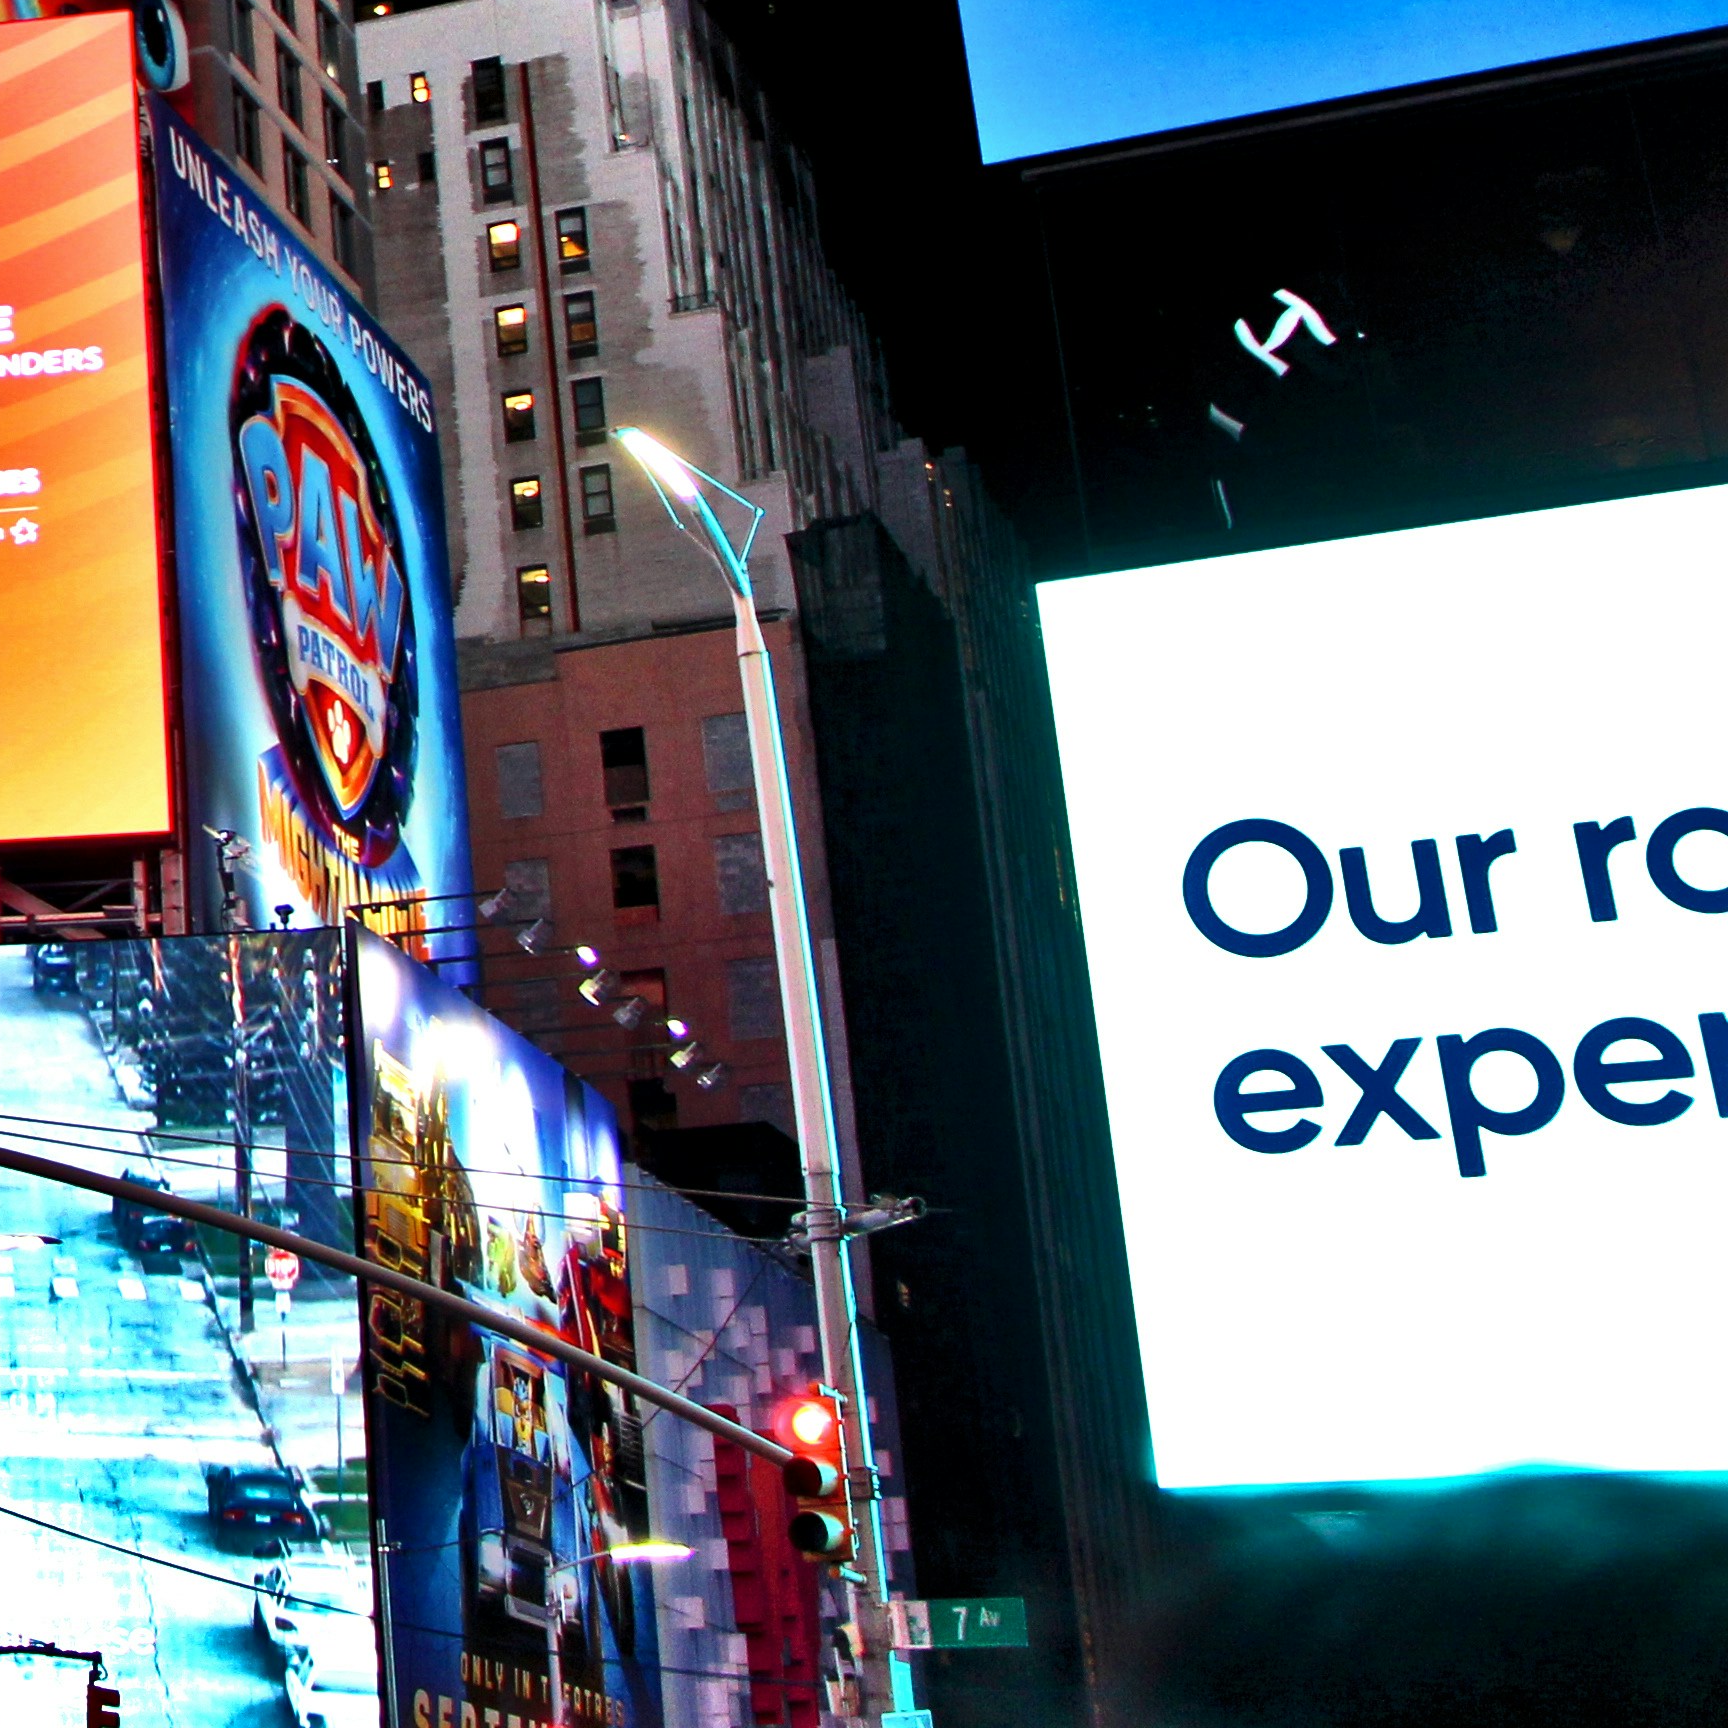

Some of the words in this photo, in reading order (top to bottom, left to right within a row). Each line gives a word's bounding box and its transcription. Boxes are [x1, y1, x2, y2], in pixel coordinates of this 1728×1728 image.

[169, 126, 281, 277] UNLEASH
[284, 246, 346, 344] YOUR
[348, 313, 433, 433] POWERS
[240, 415, 404, 684] PAW
[298, 624, 375, 722] PATROL
[333, 824, 360, 863] THE
[1182, 817, 1518, 958] Our
[952, 1607, 968, 1641] 7
[460, 1651, 503, 1693] ONLY
[514, 1667, 531, 1700] IN
[540, 1675, 625, 1726] TEATRES
